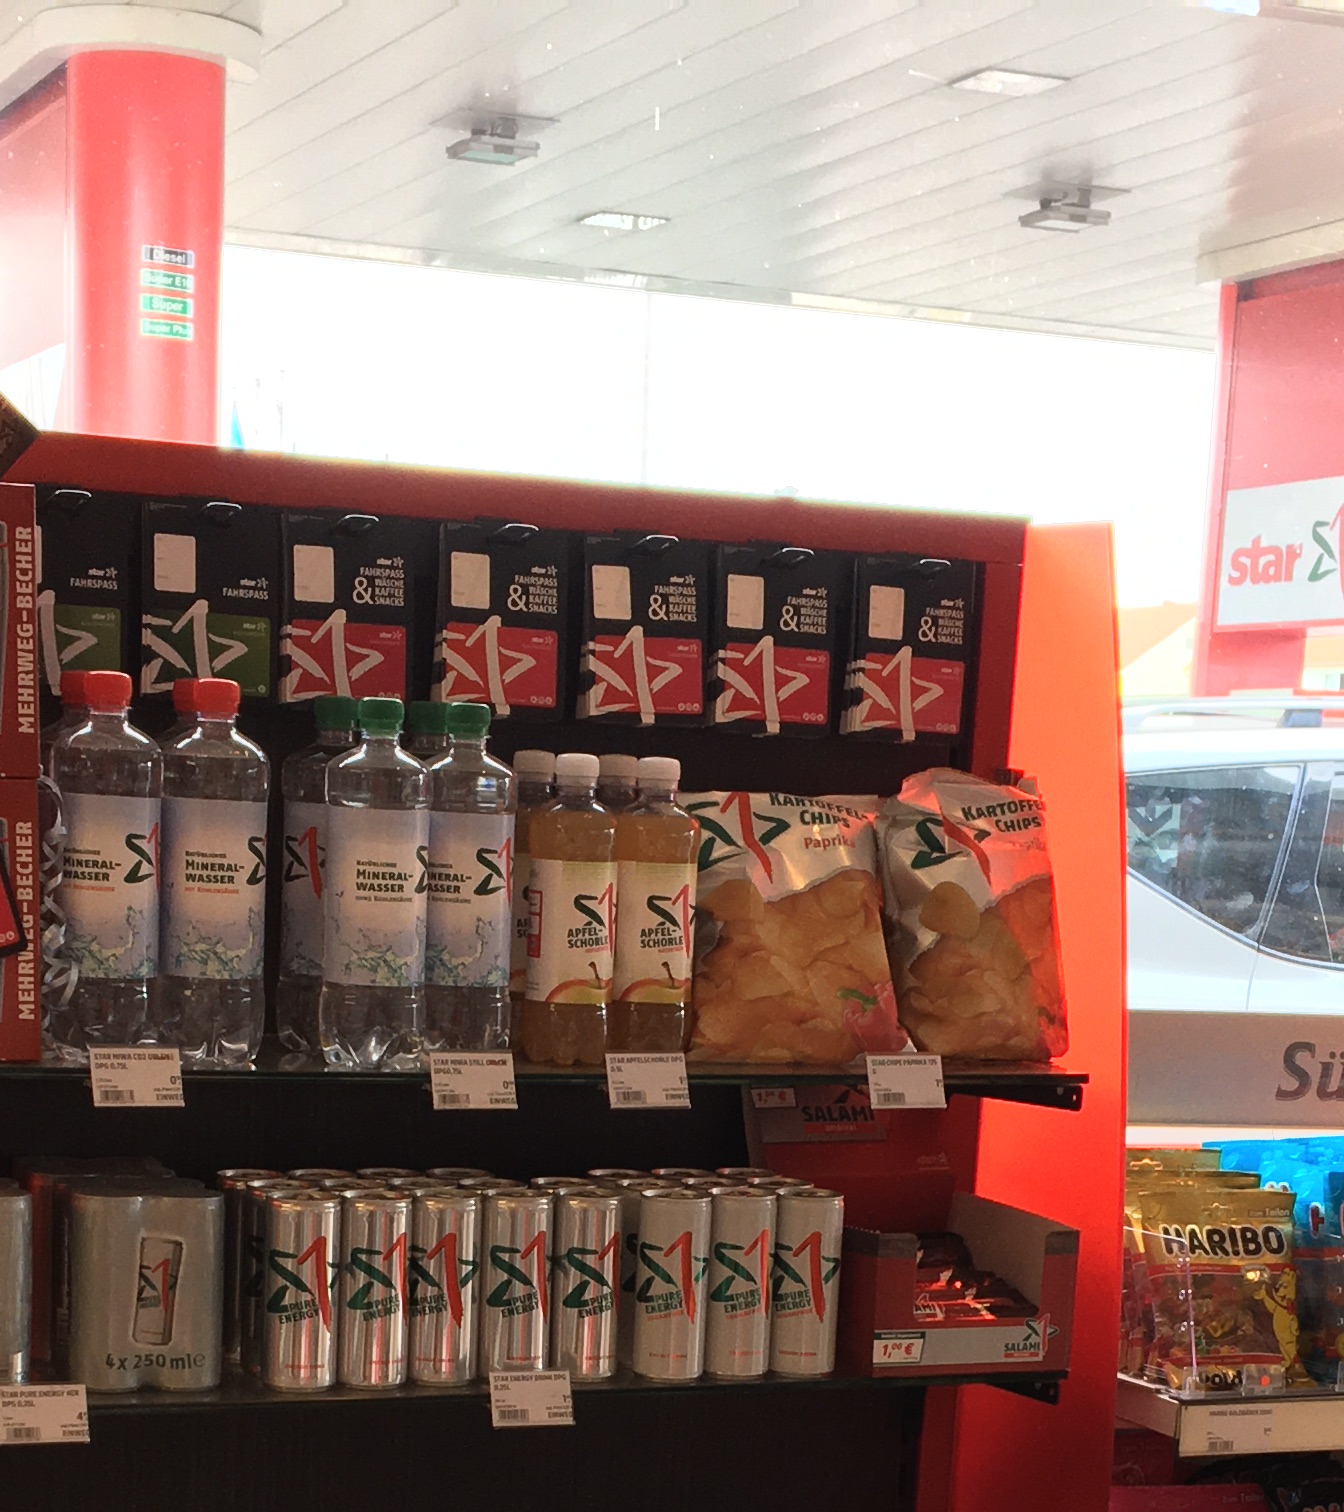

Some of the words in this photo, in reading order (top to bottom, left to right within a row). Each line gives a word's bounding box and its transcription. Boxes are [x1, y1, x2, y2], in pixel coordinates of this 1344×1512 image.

[1228, 535, 1303, 587] star
[352, 577, 373, 605] &
[15, 525, 35, 734] MEHRWEG-BECHER
[800, 809, 851, 828] CHIPS
[994, 816, 1042, 832] CHIPS
[185, 859, 245, 873] MINERAL-
[185, 873, 235, 885] WASSER
[356, 868, 413, 881] MINERAL-
[356, 882, 404, 893] WASSER
[567, 926, 603, 939] APFEL-
[640, 926, 677, 939] APFEL-
[567, 935, 609, 949] SCHORLE
[640, 936, 684, 949] SCHORLE
[802, 1104, 875, 1123] SALAMI
[1162, 1224, 1286, 1258] HARIBO
[289, 1298, 318, 1311] PURE
[645, 1300, 684, 1314] ENERGY
[278, 1308, 320, 1325] ENERGY
[1004, 1342, 1041, 1353] SALAMI
